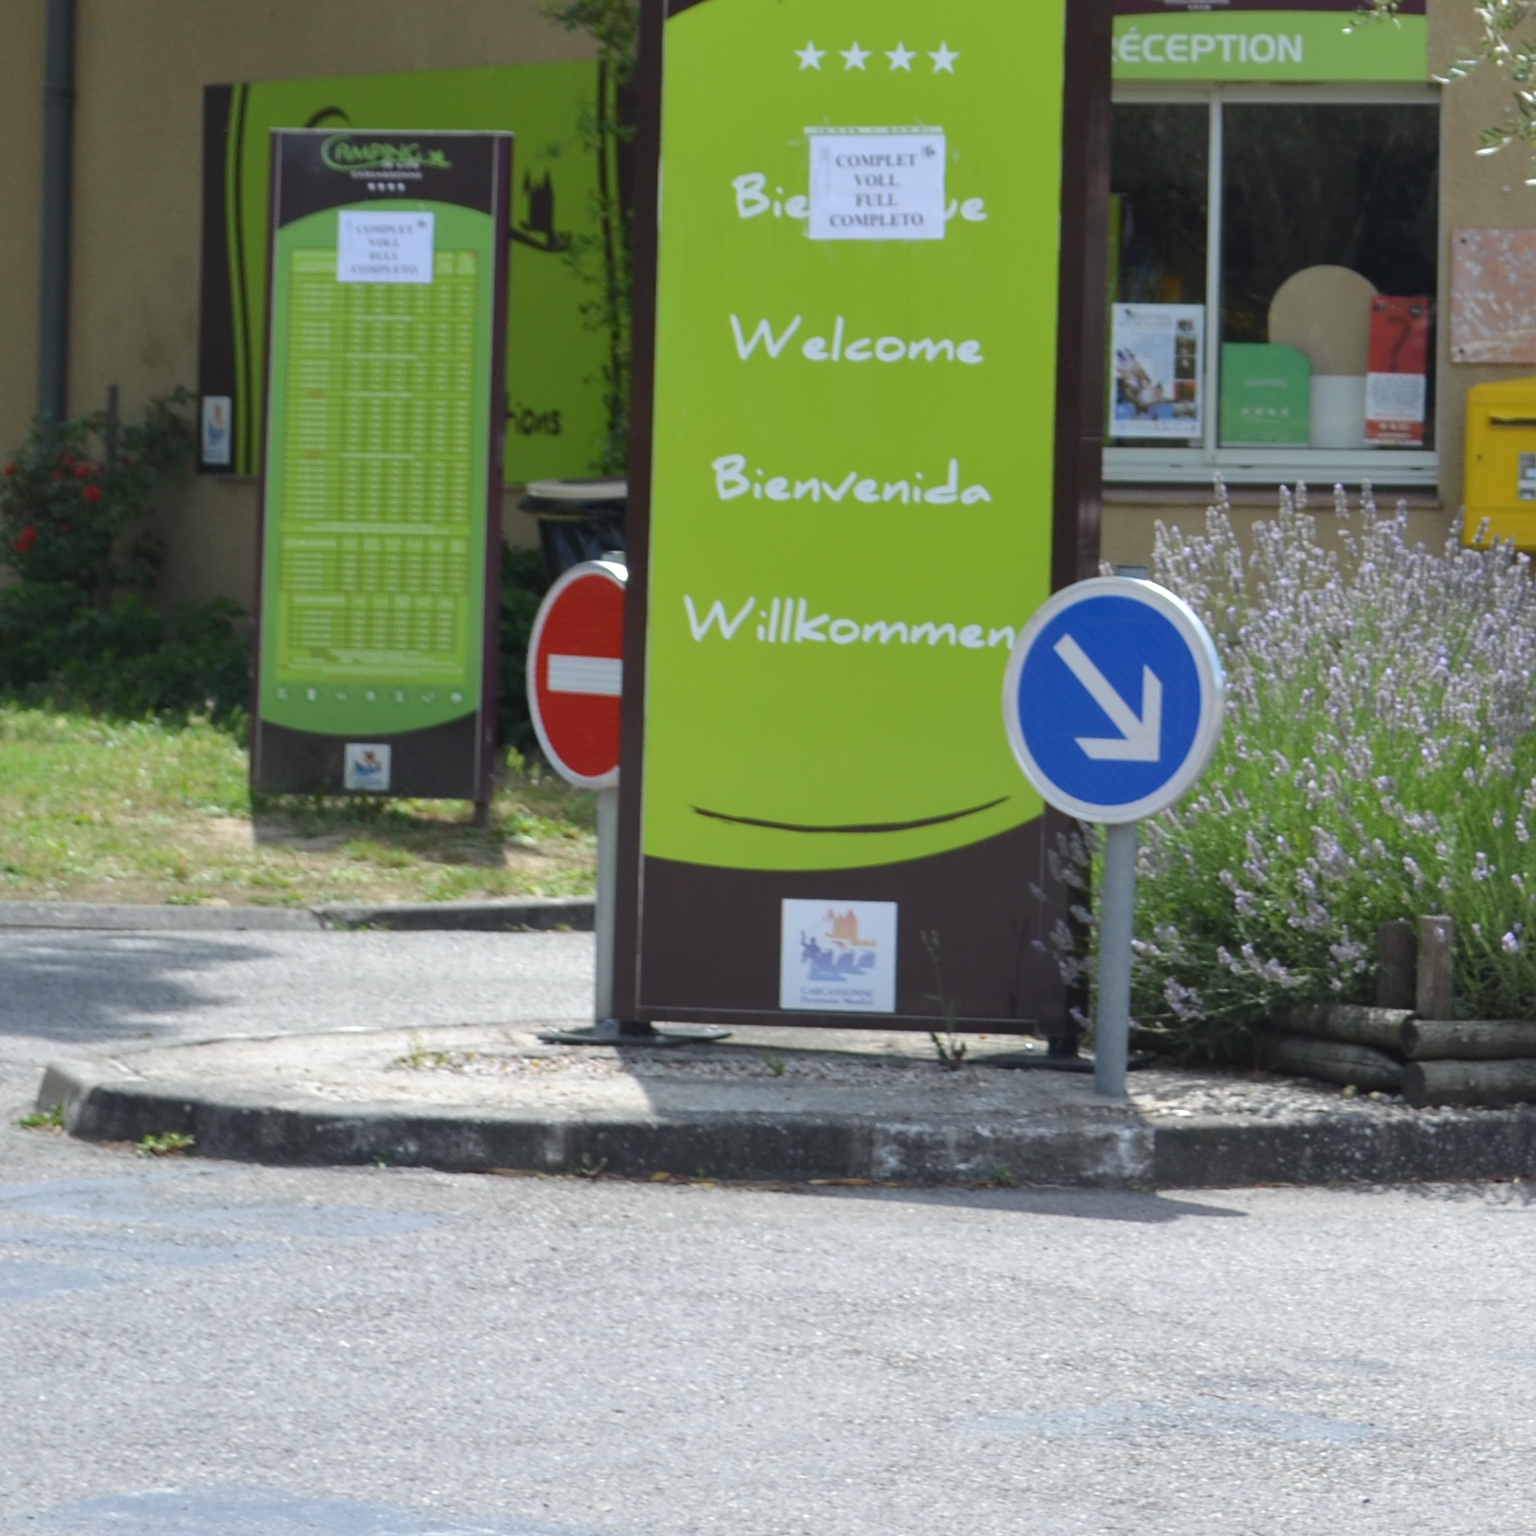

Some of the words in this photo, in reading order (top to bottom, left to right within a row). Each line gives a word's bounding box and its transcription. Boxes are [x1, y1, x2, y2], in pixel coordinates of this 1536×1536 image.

[836, 153, 918, 168] COMPLET
[854, 173, 899, 188] VOLL
[855, 193, 899, 208] FULL
[829, 213, 924, 228] COMPLETO
[730, 313, 985, 364] Welcome
[711, 453, 992, 505] Bienvenida
[683, 593, 1016, 651] Willkommen
